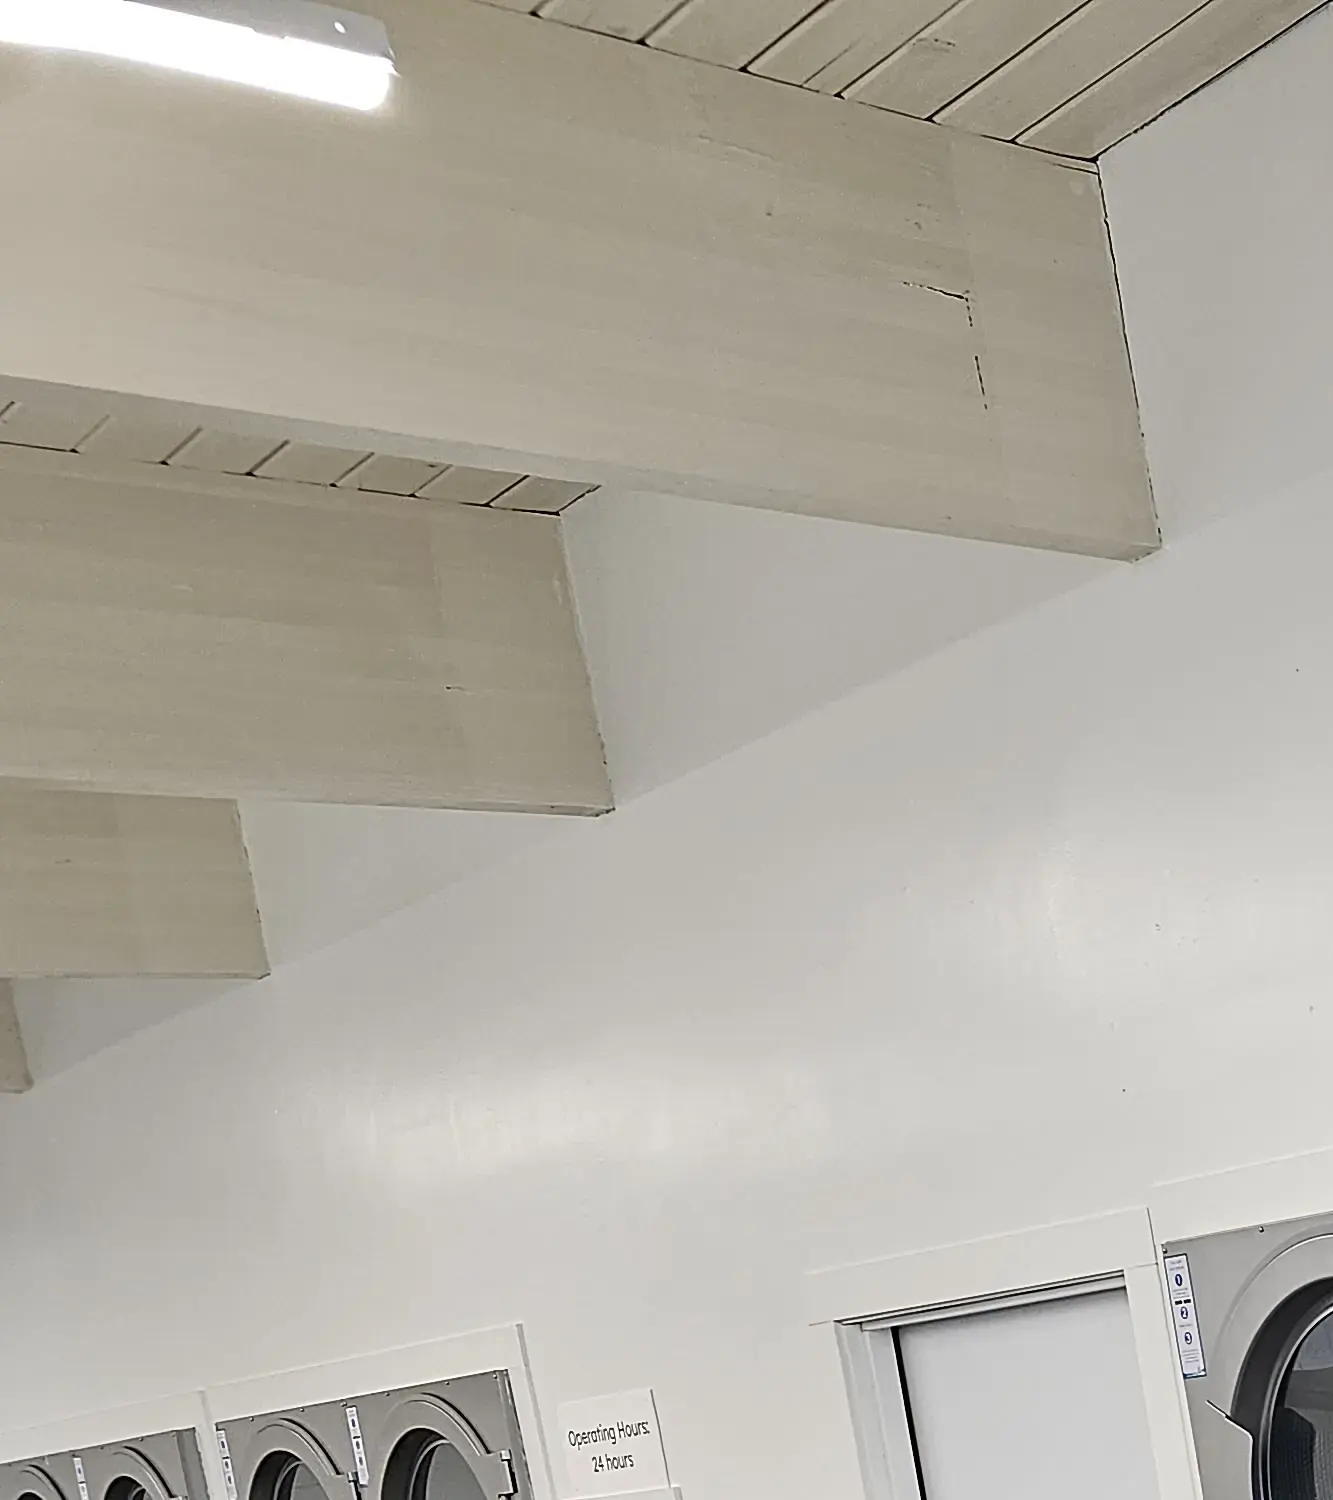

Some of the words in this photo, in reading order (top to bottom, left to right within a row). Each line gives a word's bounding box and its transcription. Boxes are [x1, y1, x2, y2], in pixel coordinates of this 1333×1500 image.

[568, 1423, 617, 1451] Operating
[617, 1421, 650, 1438] Hours:
[592, 1455, 604, 1472] 24
[605, 1454, 634, 1471] hours
